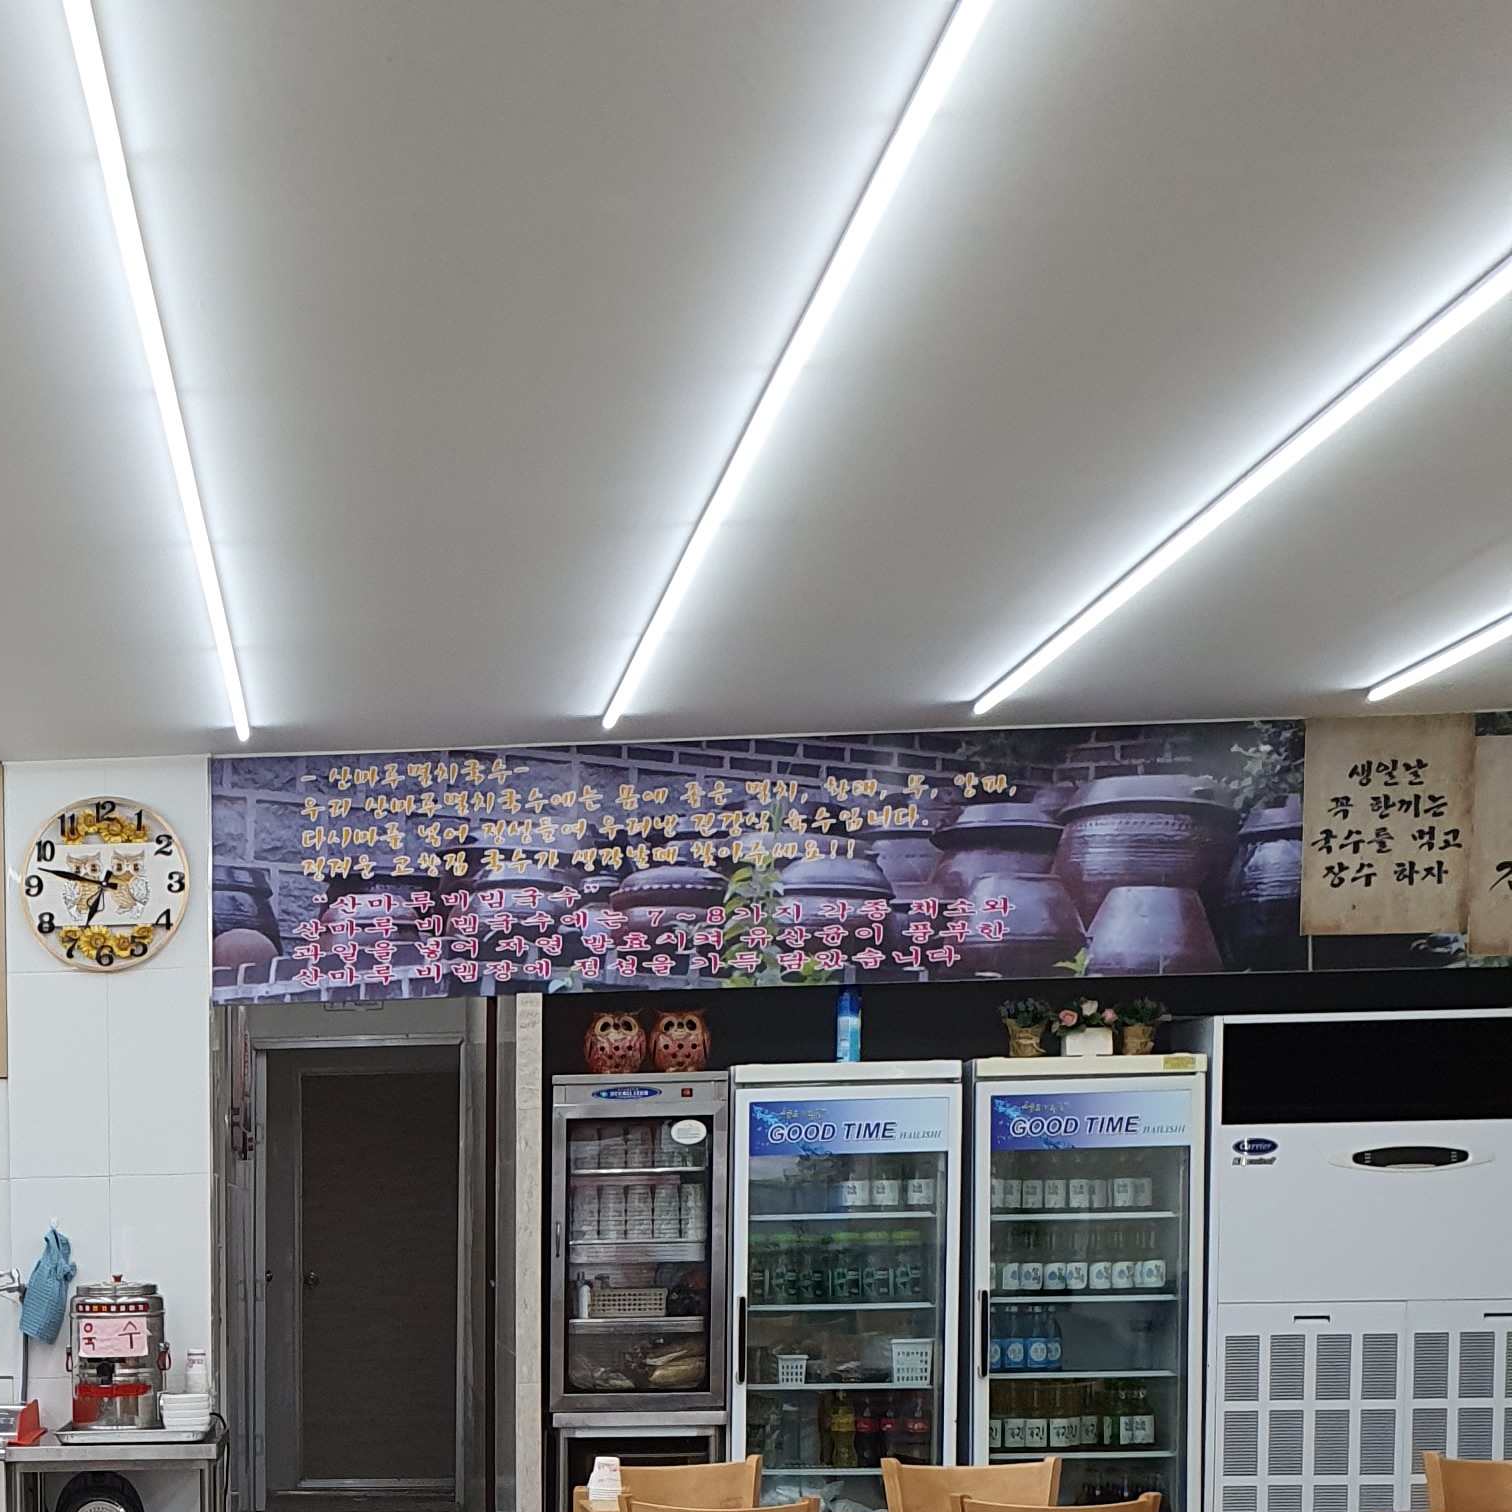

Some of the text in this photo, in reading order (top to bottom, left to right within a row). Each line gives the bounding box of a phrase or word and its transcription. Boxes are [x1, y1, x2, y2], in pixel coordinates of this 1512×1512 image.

[1348, 758, 1428, 787] 생일날
[301, 797, 352, 822] 우리
[615, 784, 669, 810] 몸에
[680, 781, 733, 808] 좋은
[746, 779, 808, 805] 멸치,
[824, 776, 888, 801] 황태,
[902, 774, 938, 799] 무,
[954, 772, 1017, 798] 양파,
[1328, 793, 1448, 820] 꼭 한끼는
[95, 800, 116, 823] 12
[134, 809, 143, 831] 1
[58, 813, 76, 836] 11
[302, 822, 406, 850] 다시마를
[418, 822, 469, 847] 넣어
[599, 814, 679, 841] 우려낸
[691, 810, 770, 837] 건강식
[784, 804, 929, 835] 육수입니다.
[36, 839, 55, 862] 10
[154, 834, 173, 856] 2
[1311, 826, 1464, 854] 국수를 먹고
[301, 854, 377, 882] 정겨운
[481, 849, 559, 874] 국수가
[1322, 859, 1449, 888] 장수 하자
[25, 874, 44, 897] 9
[167, 871, 185, 893] 3
[37, 912, 55, 934] 8
[155, 908, 173, 930] 4
[292, 917, 397, 942] 산마루
[819, 898, 891, 921] 각종
[908, 896, 1016, 919] 채소와
[62, 936, 79, 959] 7
[130, 935, 148, 957] 5
[292, 921, 1010, 965] 과일을 넣어 자연 발효시켜 유산균이 풍부한
[95, 945, 114, 967] 6
[292, 946, 961, 989] 산마루 비빔장에 정성을 가득 담았습니다
[769, 1122, 836, 1144] GOOD
[843, 1121, 898, 1141] TIME
[1011, 1115, 1080, 1137] GOOD
[1086, 1115, 1140, 1135] TIME
